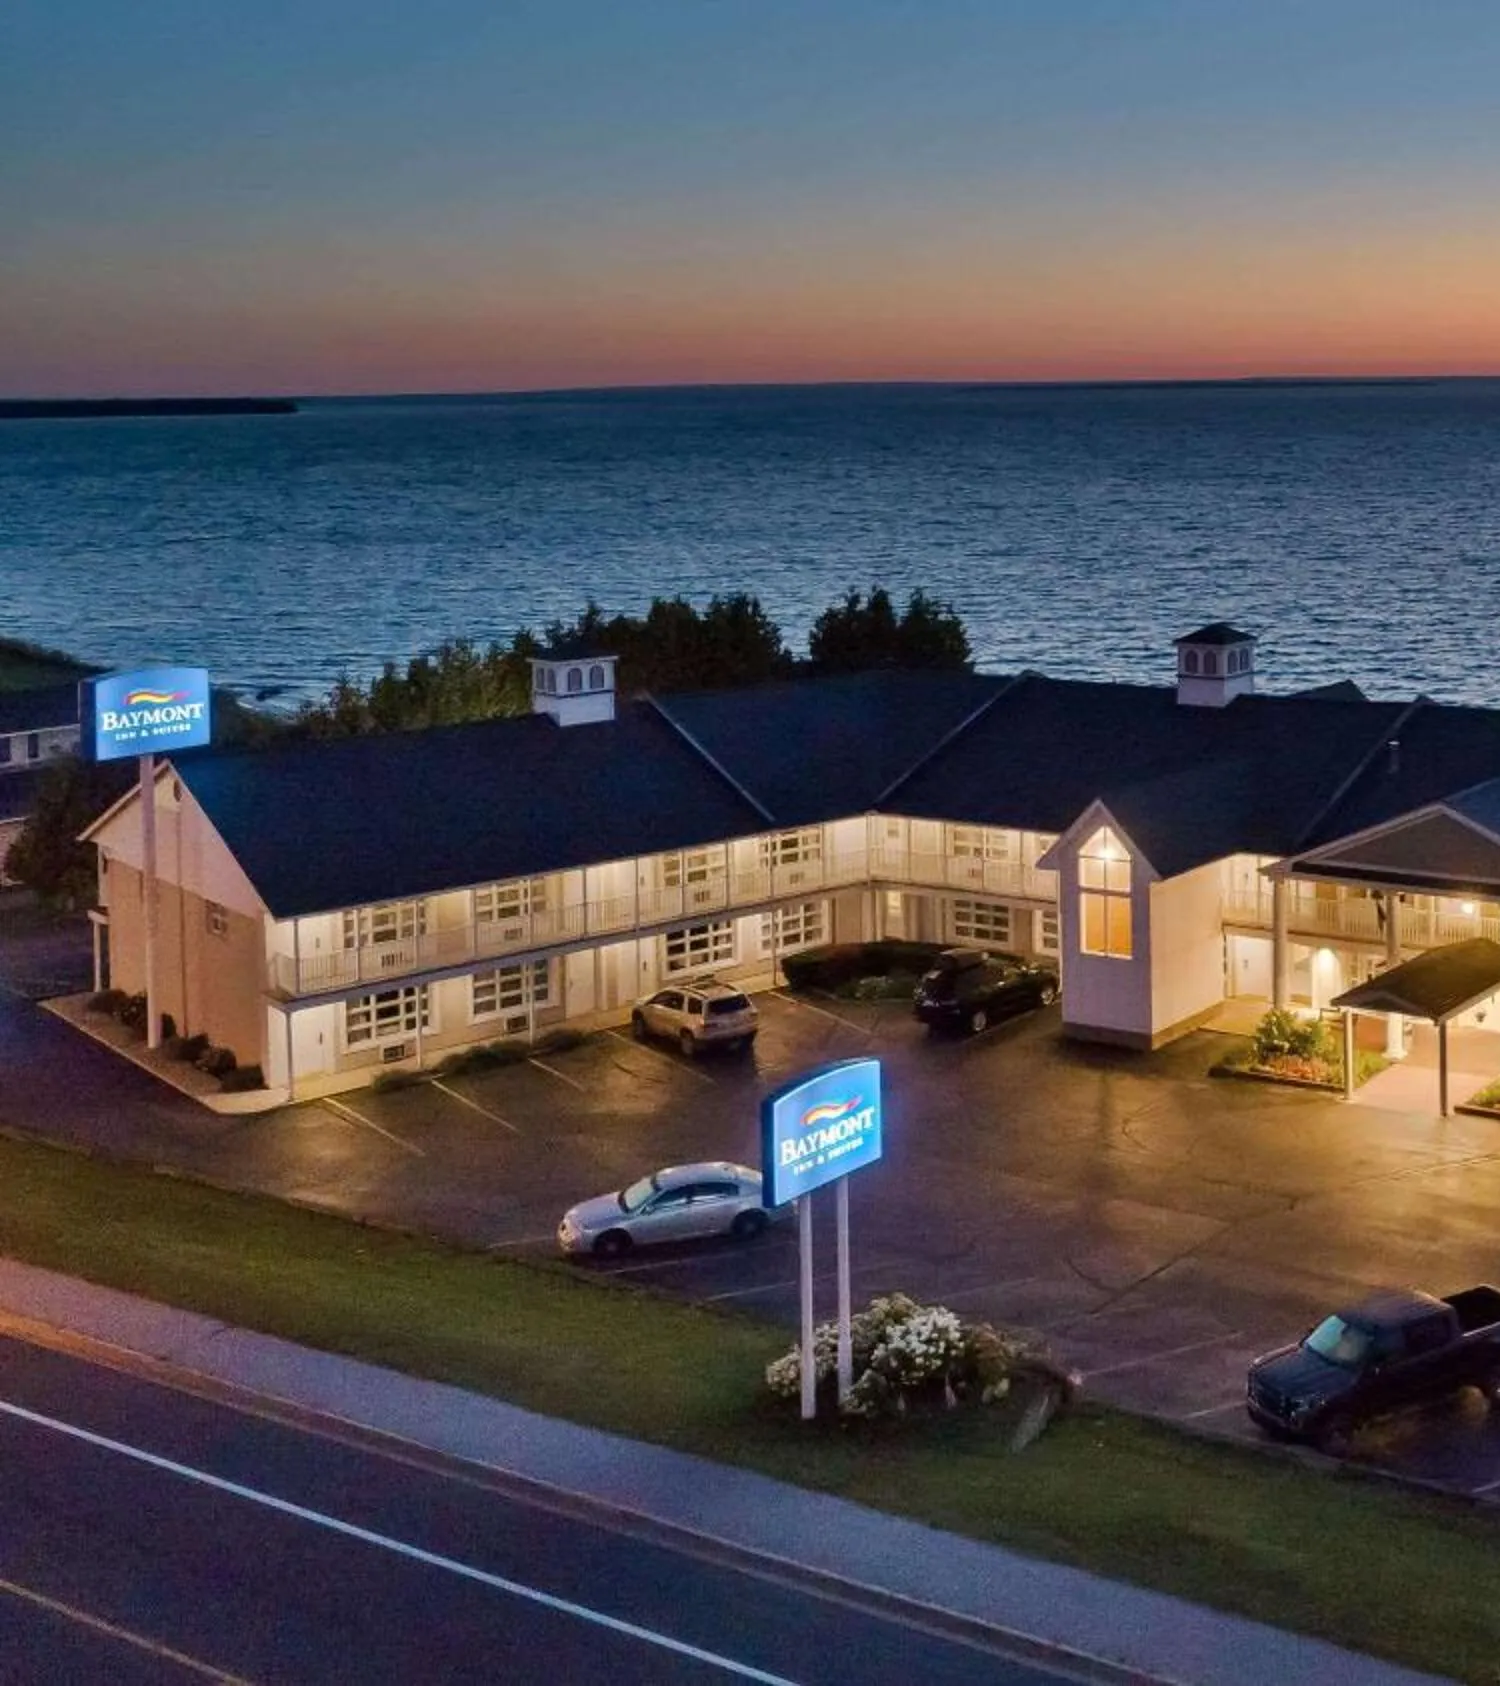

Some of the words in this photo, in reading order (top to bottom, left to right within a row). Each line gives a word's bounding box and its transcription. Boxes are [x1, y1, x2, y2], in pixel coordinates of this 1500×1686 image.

[102, 703, 204, 732] BAYMONT
[115, 731, 137, 741] INN
[153, 723, 191, 736] SUITES
[780, 1106, 875, 1166] BAYMONT
